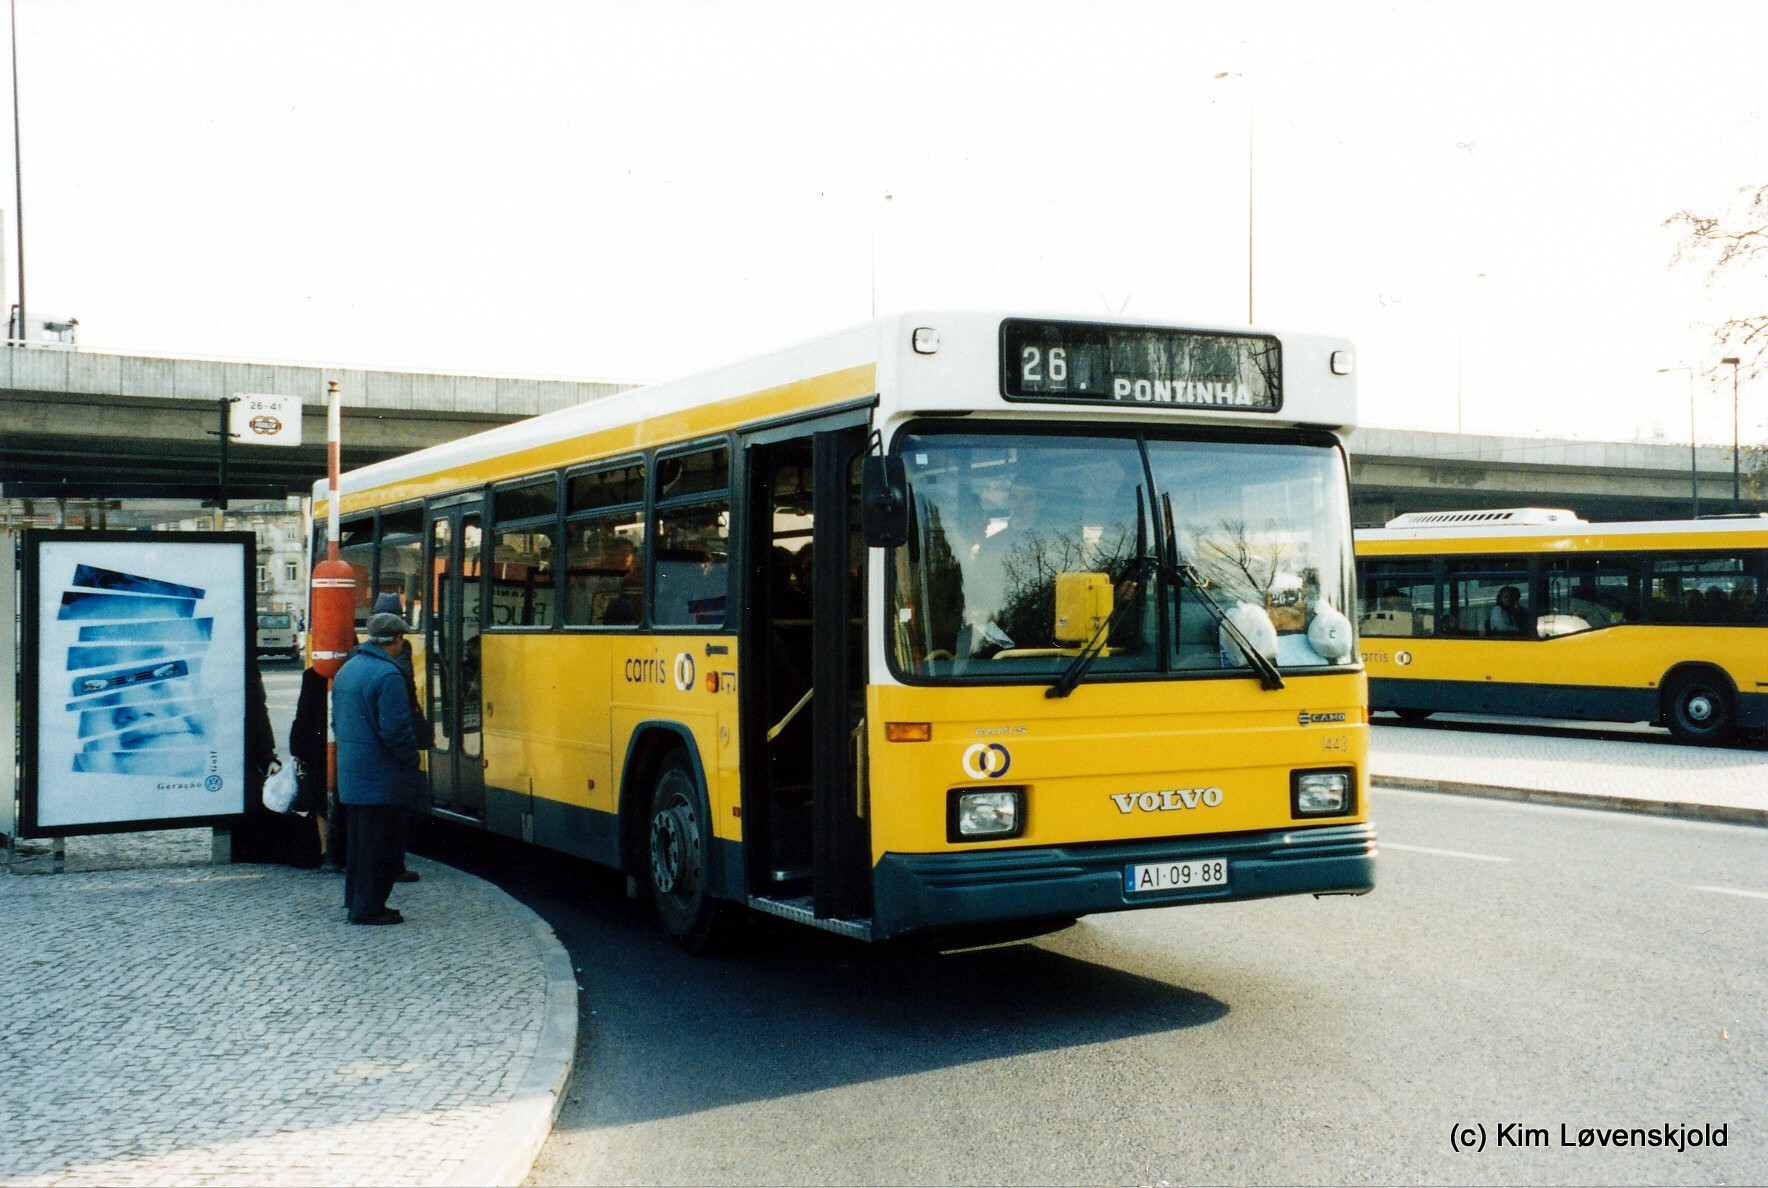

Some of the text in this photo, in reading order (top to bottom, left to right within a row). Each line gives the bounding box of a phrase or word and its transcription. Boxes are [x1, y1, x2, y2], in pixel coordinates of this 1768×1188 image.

[1022, 346, 1068, 382] 26
[1113, 378, 1254, 406] PONTINHA
[625, 648, 666, 684] carris
[1361, 649, 1389, 663] arris
[1110, 787, 1224, 814] VOLVO
